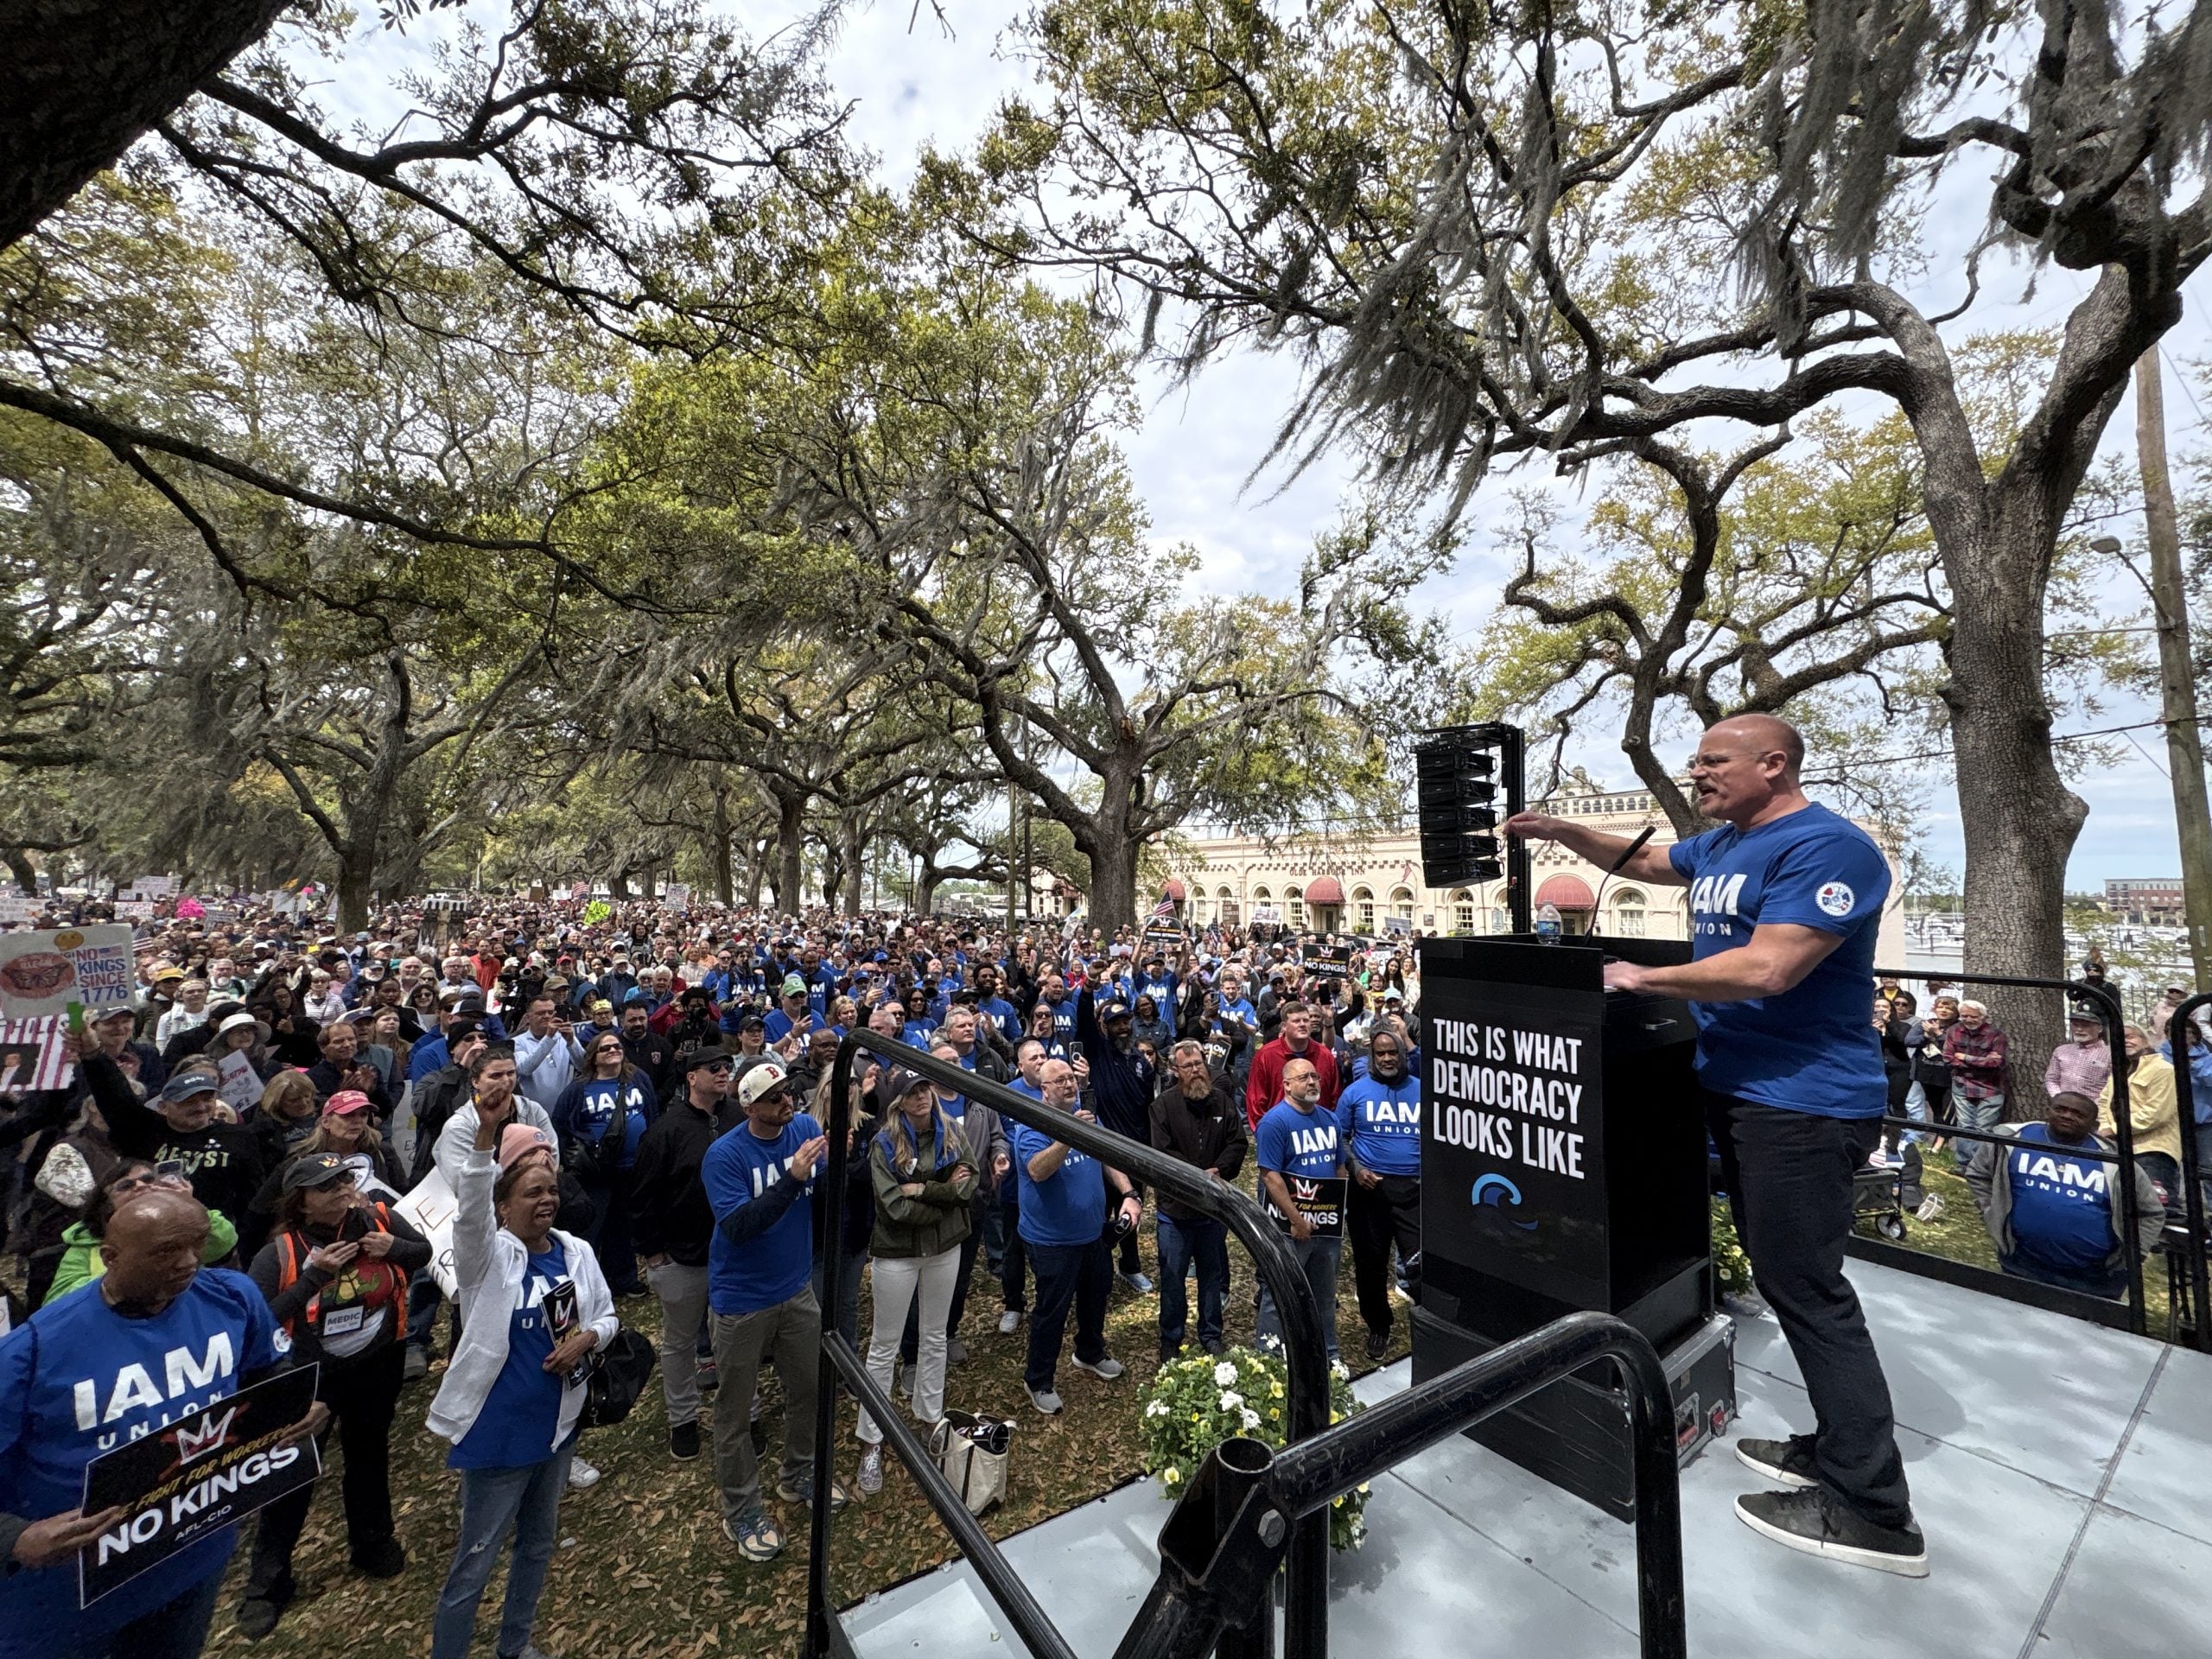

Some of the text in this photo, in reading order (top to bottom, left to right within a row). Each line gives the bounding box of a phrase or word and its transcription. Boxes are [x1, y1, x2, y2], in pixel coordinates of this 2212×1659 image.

[76, 949, 99, 962] NO
[78, 958, 126, 975] KINGS
[1319, 963, 1347, 973] KINGS
[79, 971, 127, 988] SINCE
[80, 984, 128, 1003] 1776
[1433, 1018, 1582, 1075] THIS IS WHAT
[766, 1066, 779, 1079] B
[1433, 1058, 1582, 1124] DEMOCRACY
[1367, 1101, 1421, 1123] IAM
[1292, 1126, 1338, 1154] IAM
[1433, 1102, 1585, 1180] LOOKS LIKE
[1301, 1153, 1337, 1166] UNION
[2018, 1153, 2106, 1194] IAM
[2025, 1179, 2094, 1202] UNION
[327, 1312, 361, 1325] MEDIC
[74, 1332, 234, 1432] IAM
[98, 1390, 223, 1451] UNION
[134, 1474, 185, 1511] FIGHT
[185, 1459, 219, 1486] FOR
[98, 1444, 300, 1567] NO KINGS
[175, 1504, 232, 1542] AFL-CIO
